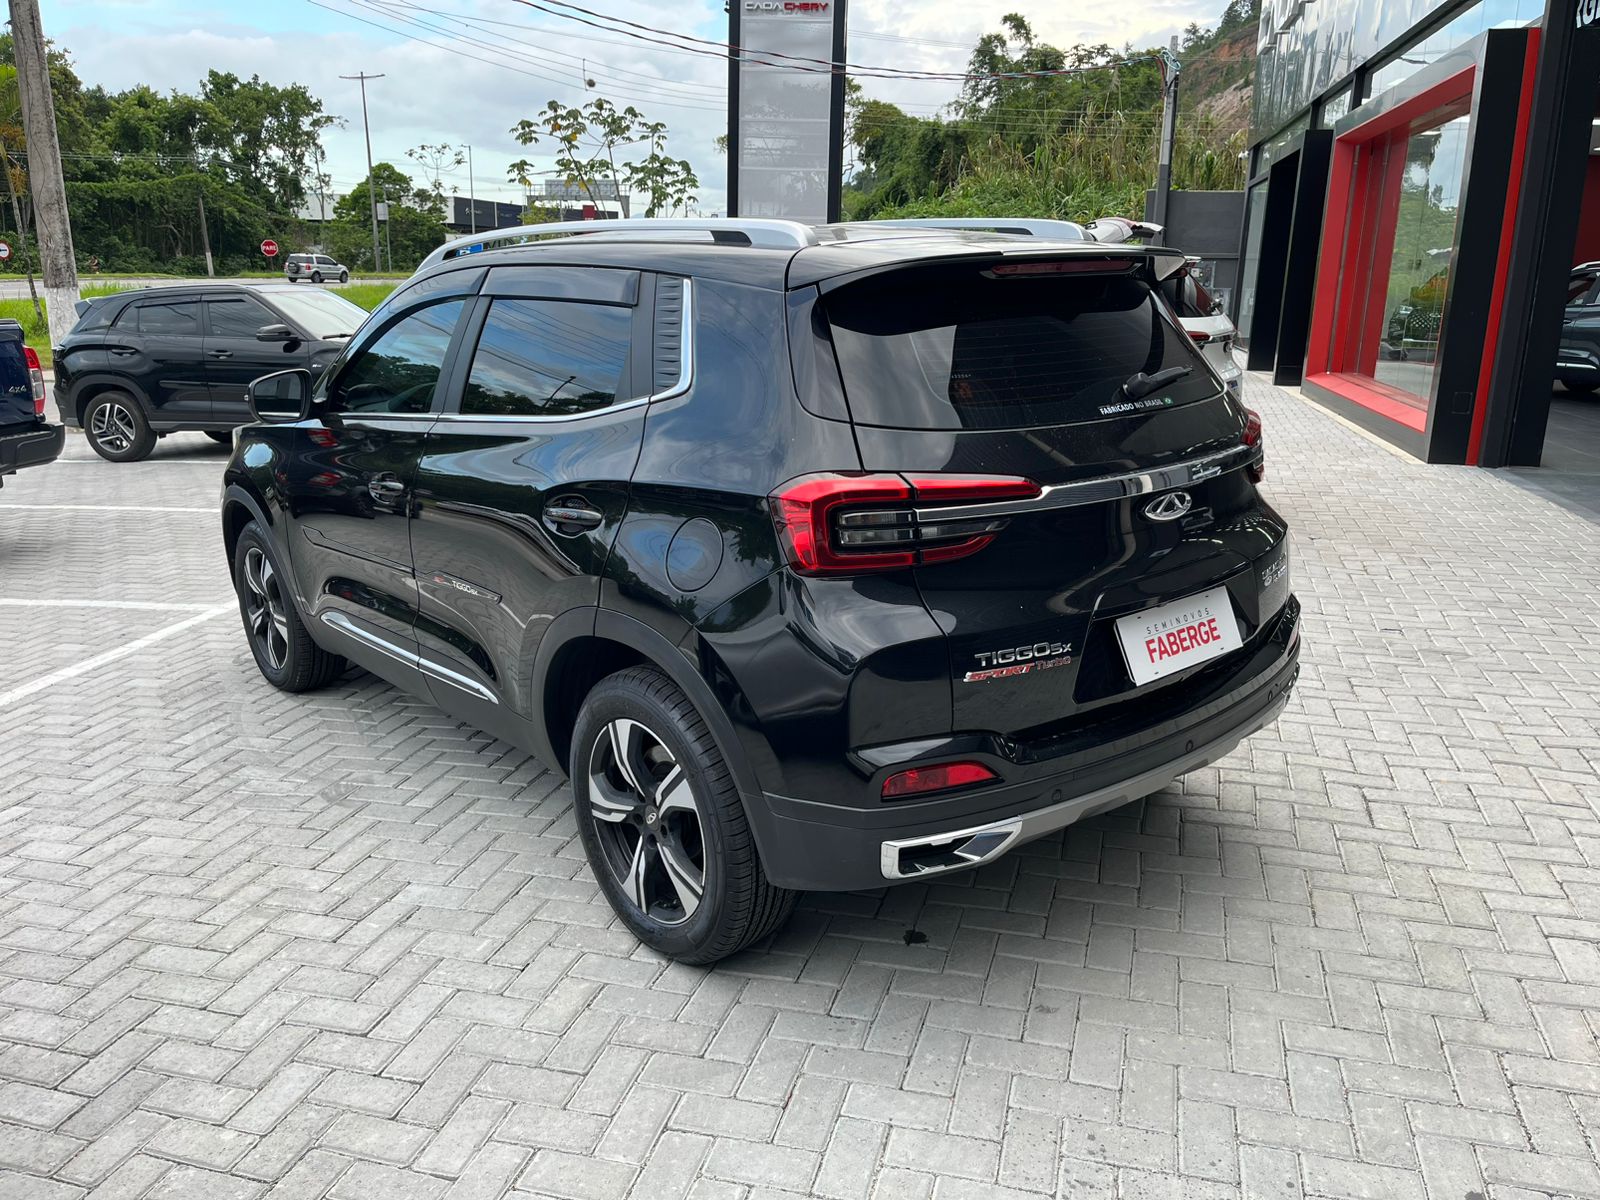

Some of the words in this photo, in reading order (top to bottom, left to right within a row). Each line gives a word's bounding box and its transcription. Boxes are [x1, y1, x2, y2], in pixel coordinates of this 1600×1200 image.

[744, 2, 781, 10] CAOA
[784, 2, 829, 11] CHERY
[1100, 403, 1134, 415] FABRICADO
[1144, 399, 1164, 407] BRASIL
[1146, 607, 1210, 634] SEMINOVOS
[1145, 617, 1221, 664] FABERGE
[963, 662, 1036, 683] SPORT
